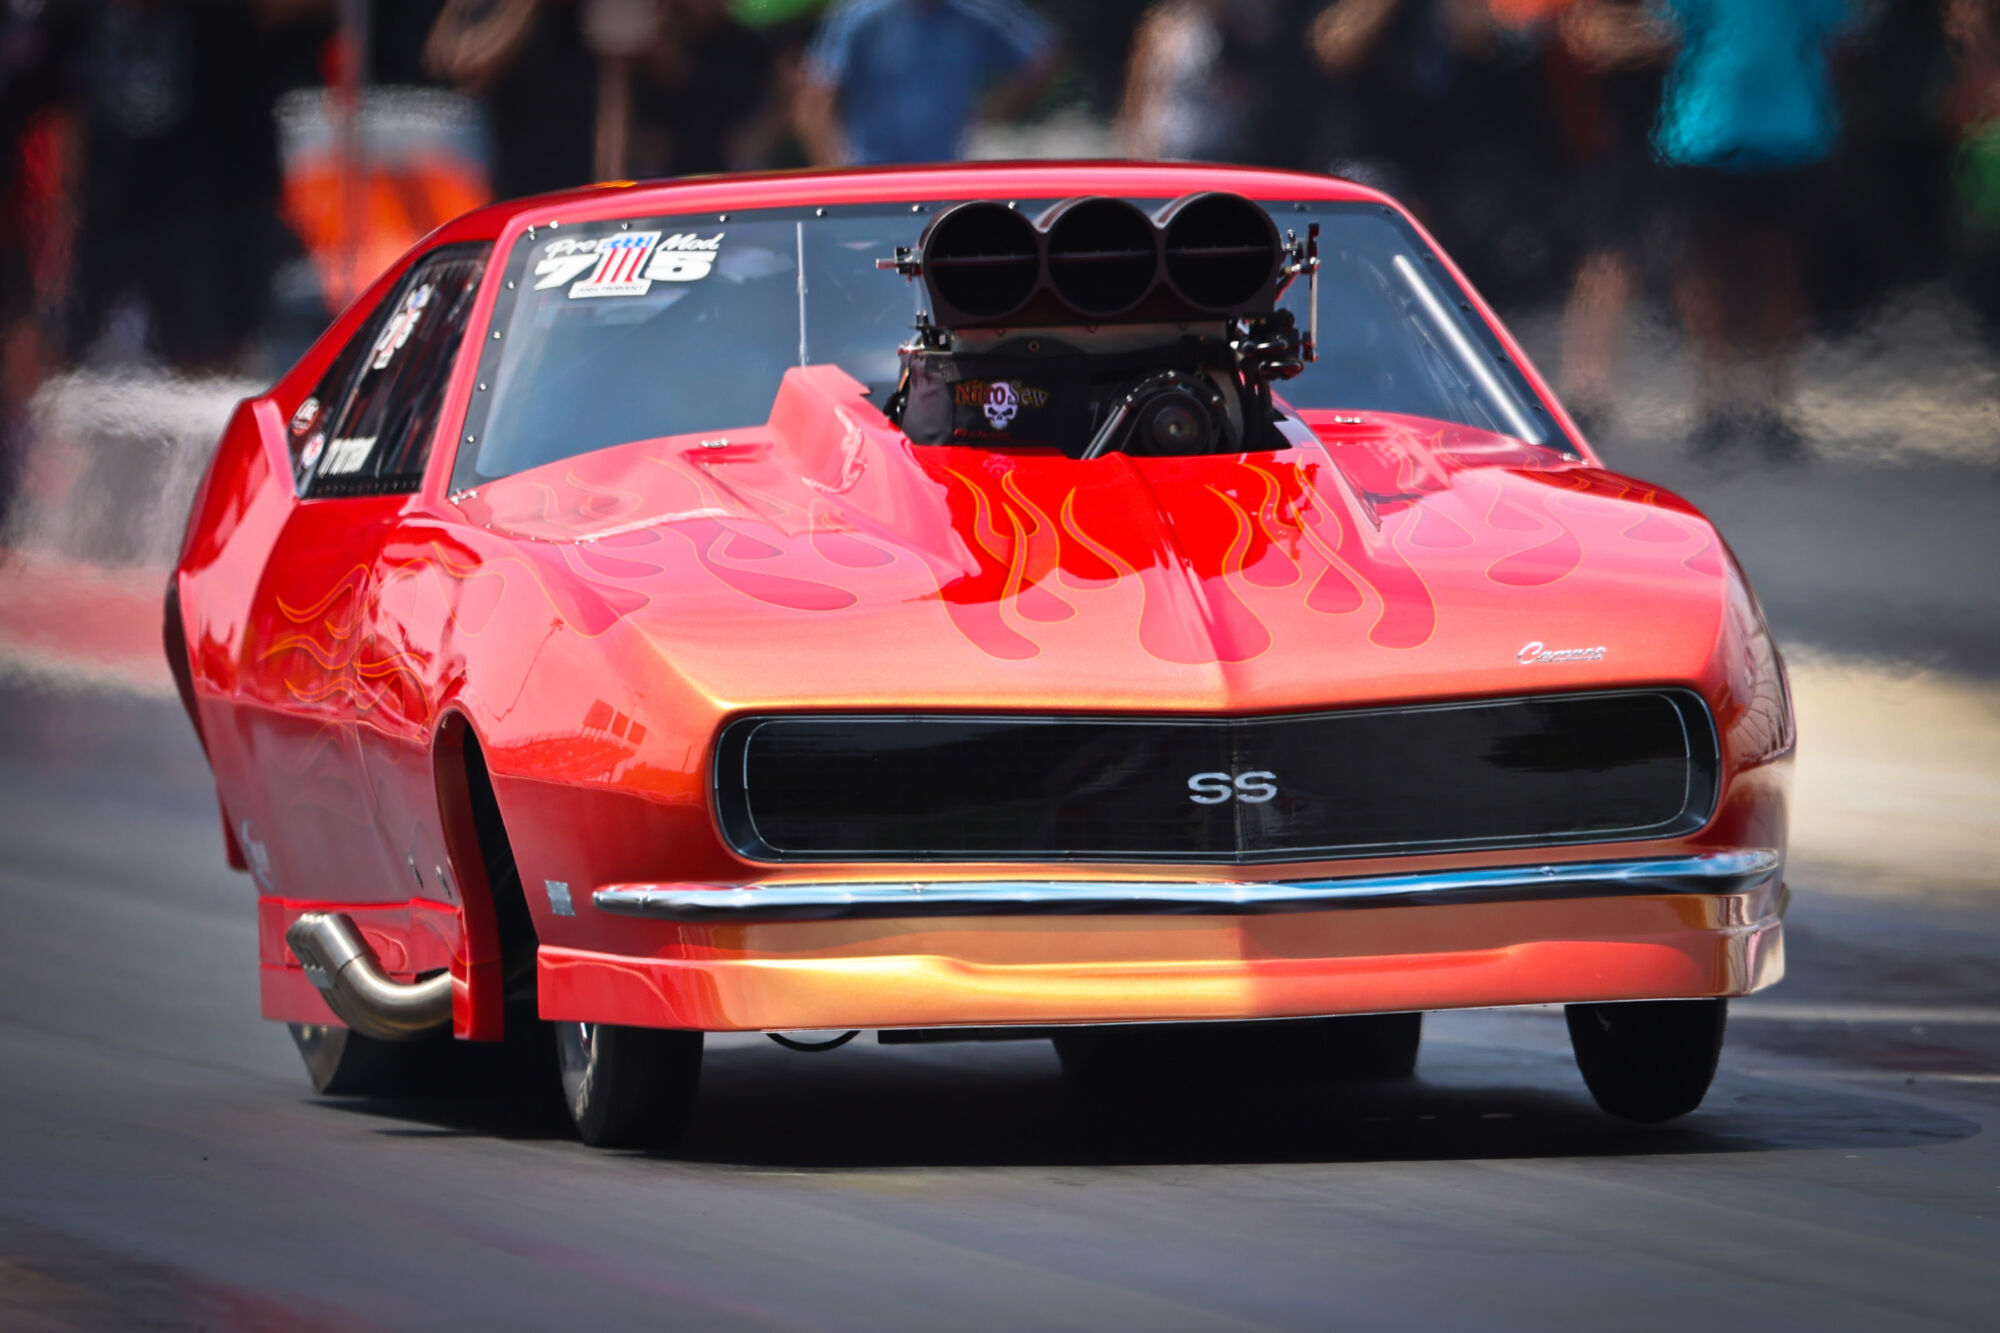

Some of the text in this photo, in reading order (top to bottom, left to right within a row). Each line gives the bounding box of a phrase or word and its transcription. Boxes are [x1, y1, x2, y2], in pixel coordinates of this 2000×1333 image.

[544, 232, 725, 259] Pro Mod
[1187, 770, 1278, 804] SS
